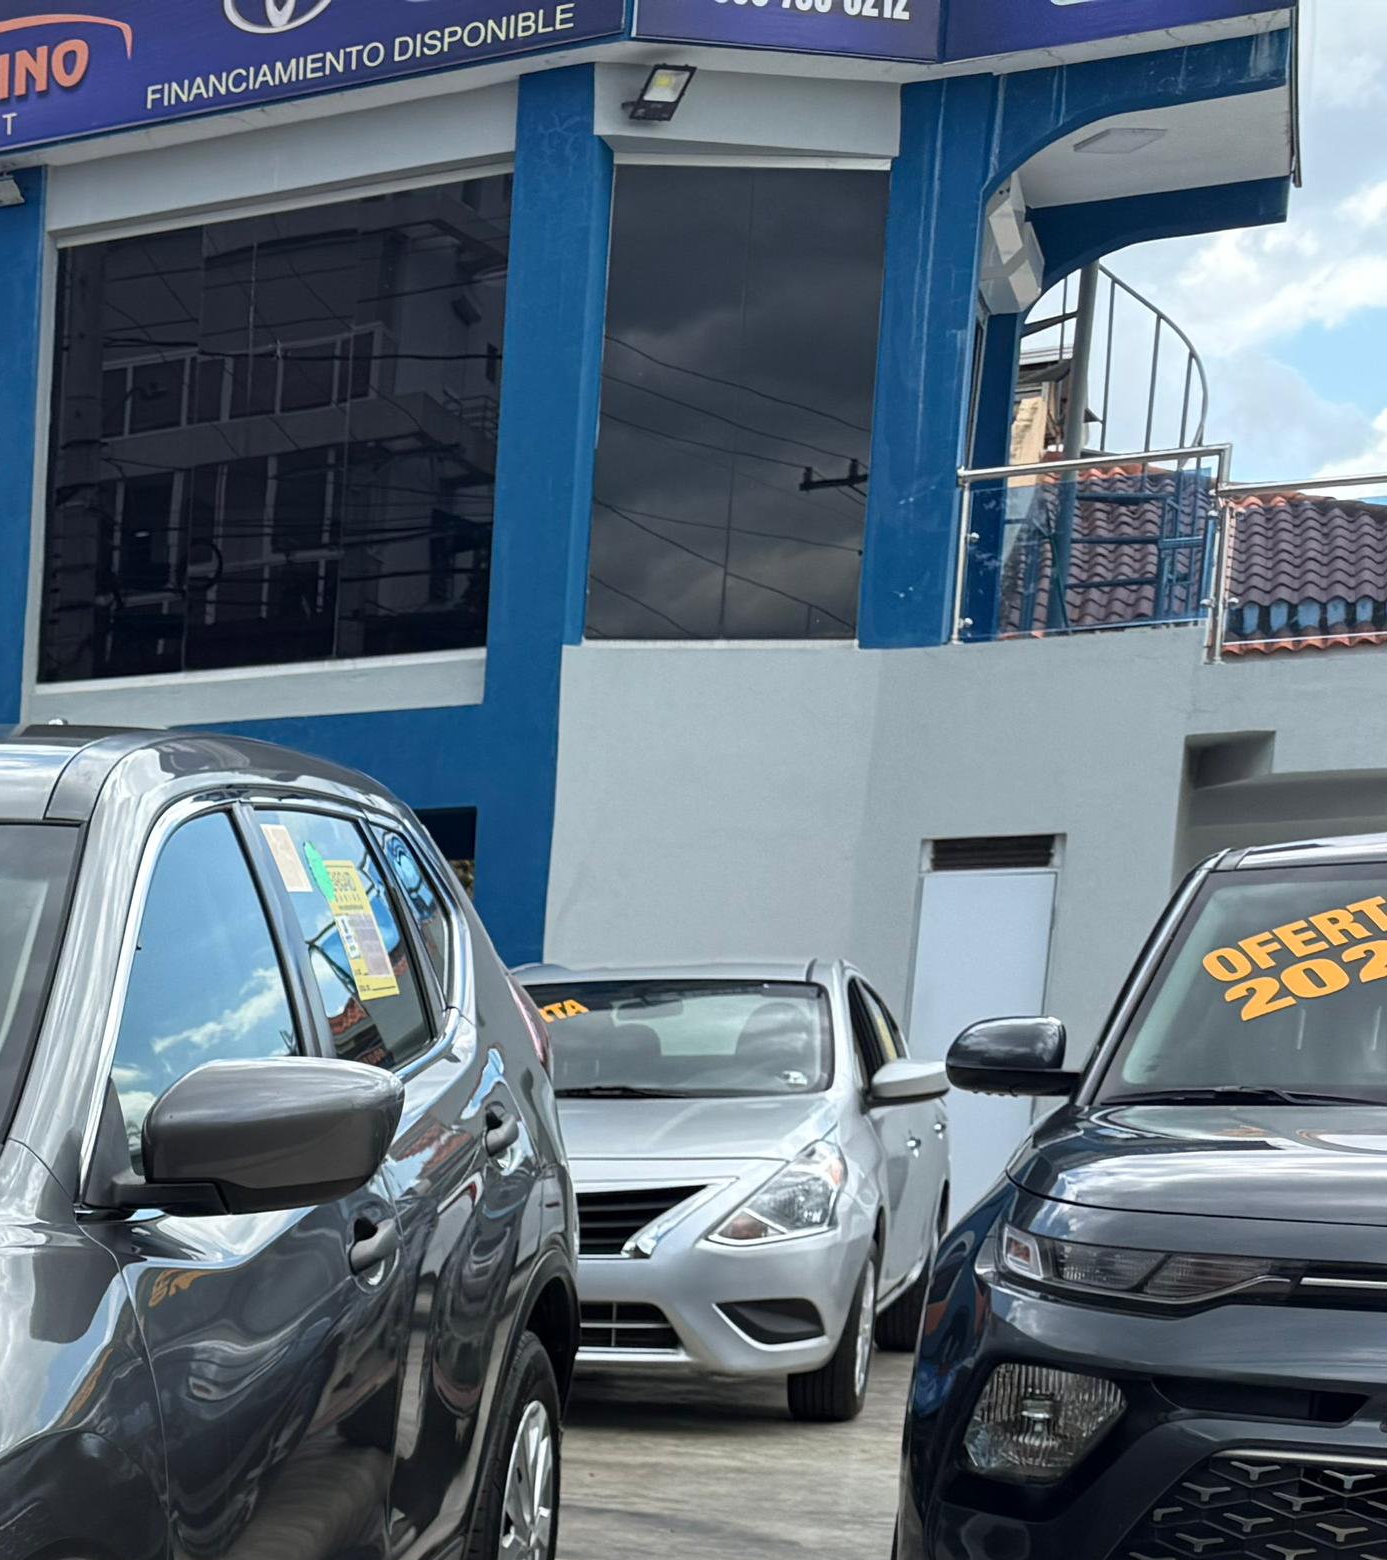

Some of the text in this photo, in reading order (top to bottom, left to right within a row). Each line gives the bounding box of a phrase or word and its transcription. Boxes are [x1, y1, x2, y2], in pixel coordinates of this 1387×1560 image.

[146, 3, 576, 110] FINANCIAMIENTO DISPONIBLE
[1201, 895, 1387, 983] OFERT
[1223, 938, 1387, 1022] 202
